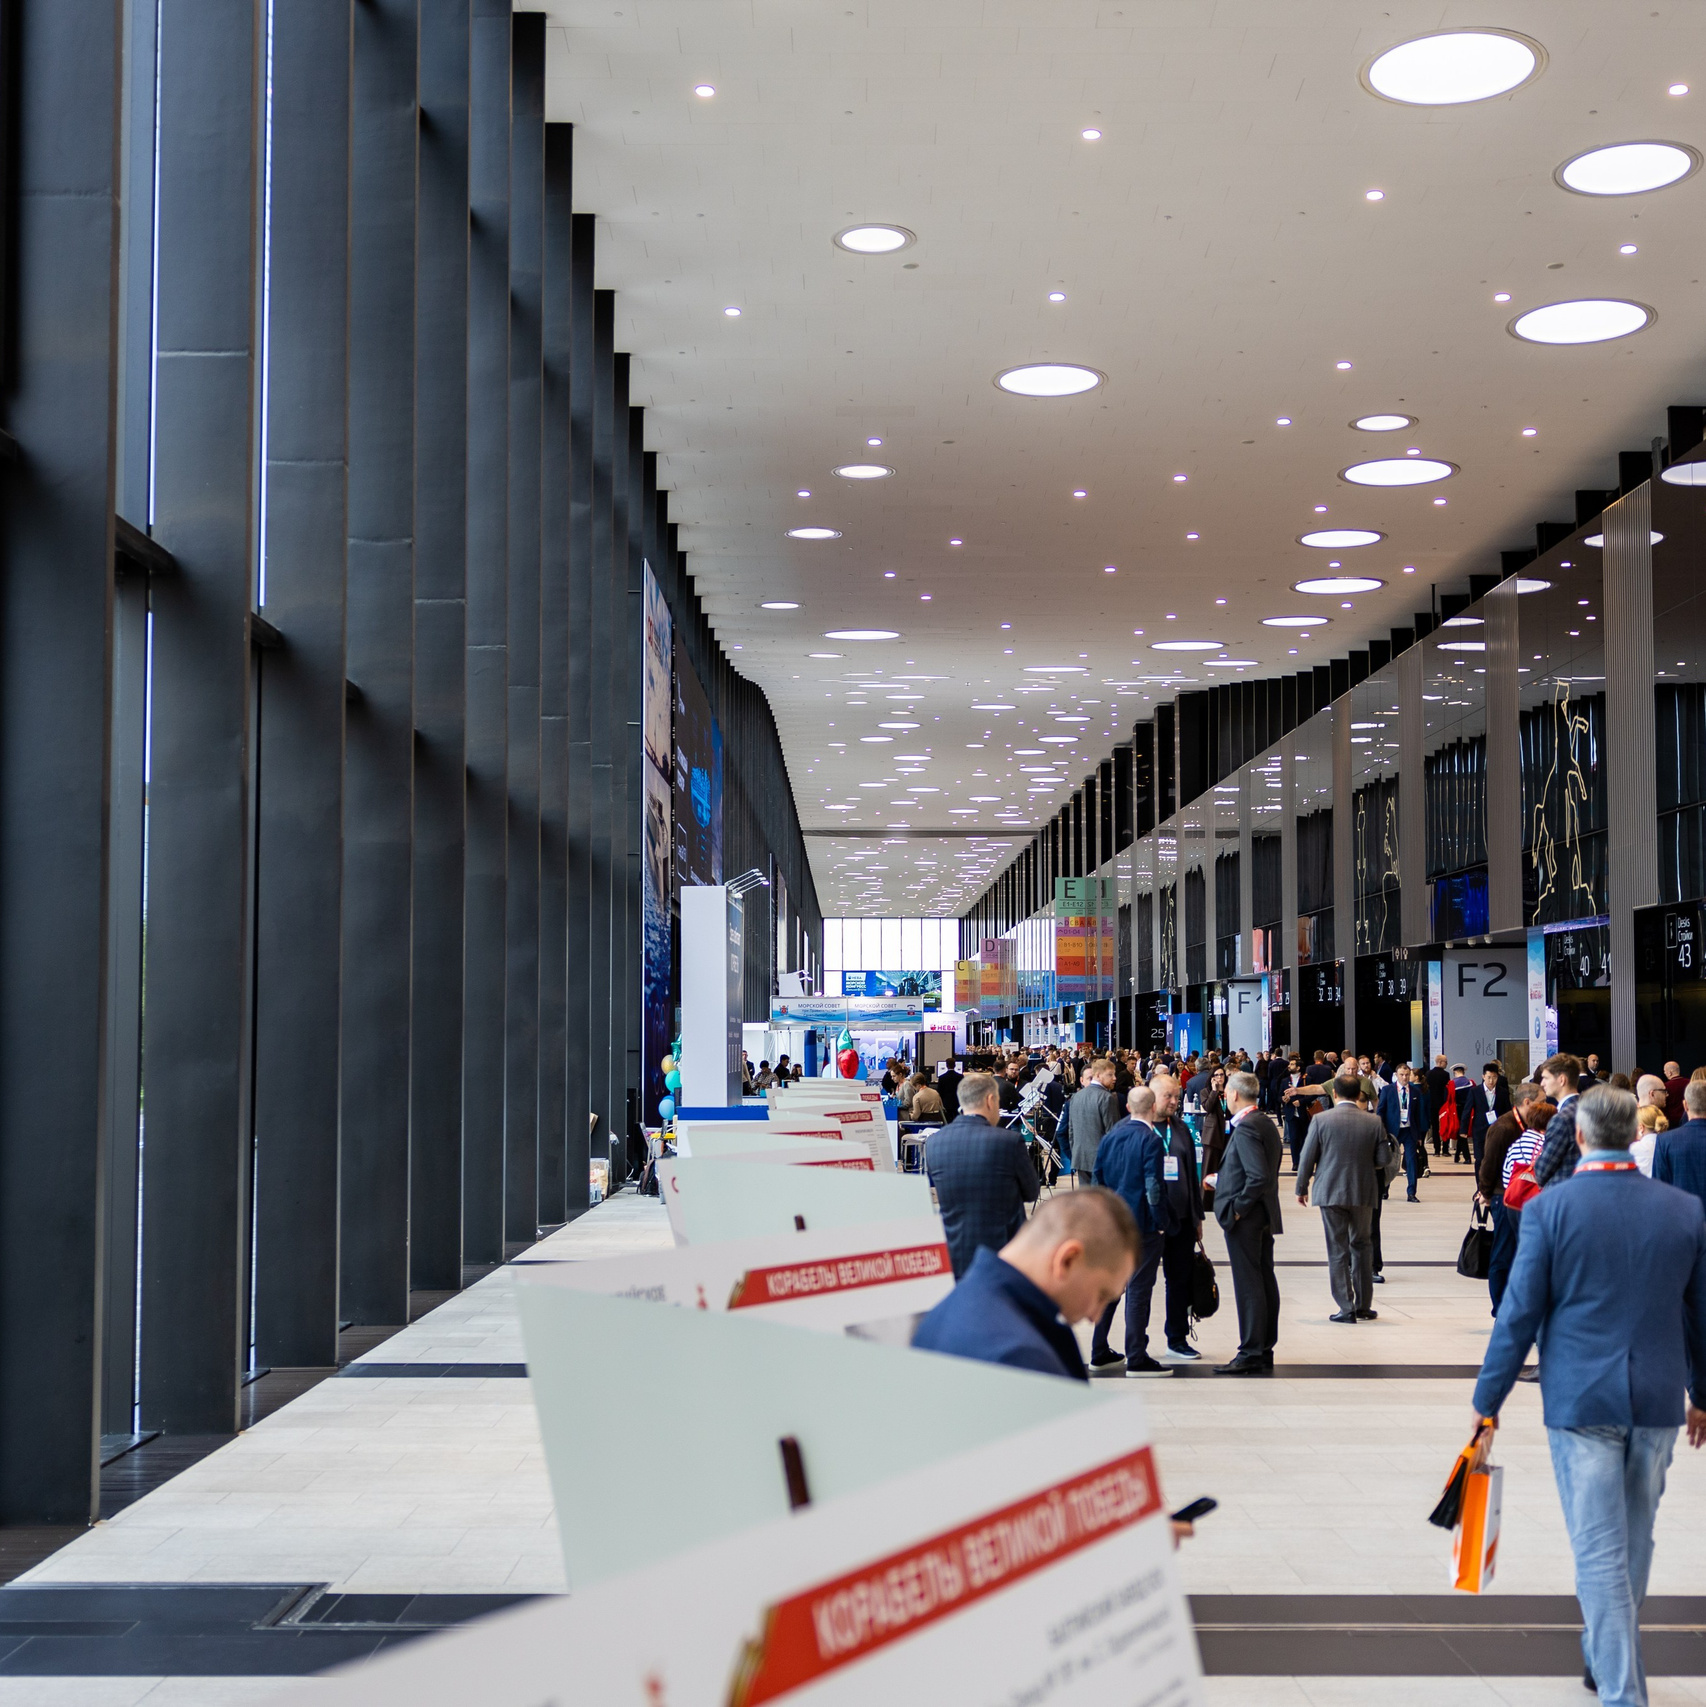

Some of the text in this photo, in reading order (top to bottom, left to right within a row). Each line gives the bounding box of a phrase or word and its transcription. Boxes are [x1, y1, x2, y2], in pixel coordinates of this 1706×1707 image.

[1064, 880, 1076, 898] E
[1677, 916, 1691, 929] Desks
[1677, 929, 1694, 942] Стойки
[985, 940, 995, 952] D
[1579, 952, 1612, 976] 40 41
[1678, 943, 1692, 968] 43
[957, 960, 965, 971] C
[1457, 962, 1508, 998] F2
[1151, 1028, 1165, 1039] 25
[765, 1247, 943, 1298] КОРАБЕЛЫ ВЕЛИКОЙ ПОБЕДЫ
[811, 1540, 965, 1661] КОРАБЕЛЫ
[961, 1489, 1068, 1589] ВЕЛИКОЙ
[1064, 1460, 1153, 1535] ПОБЕДЫ
